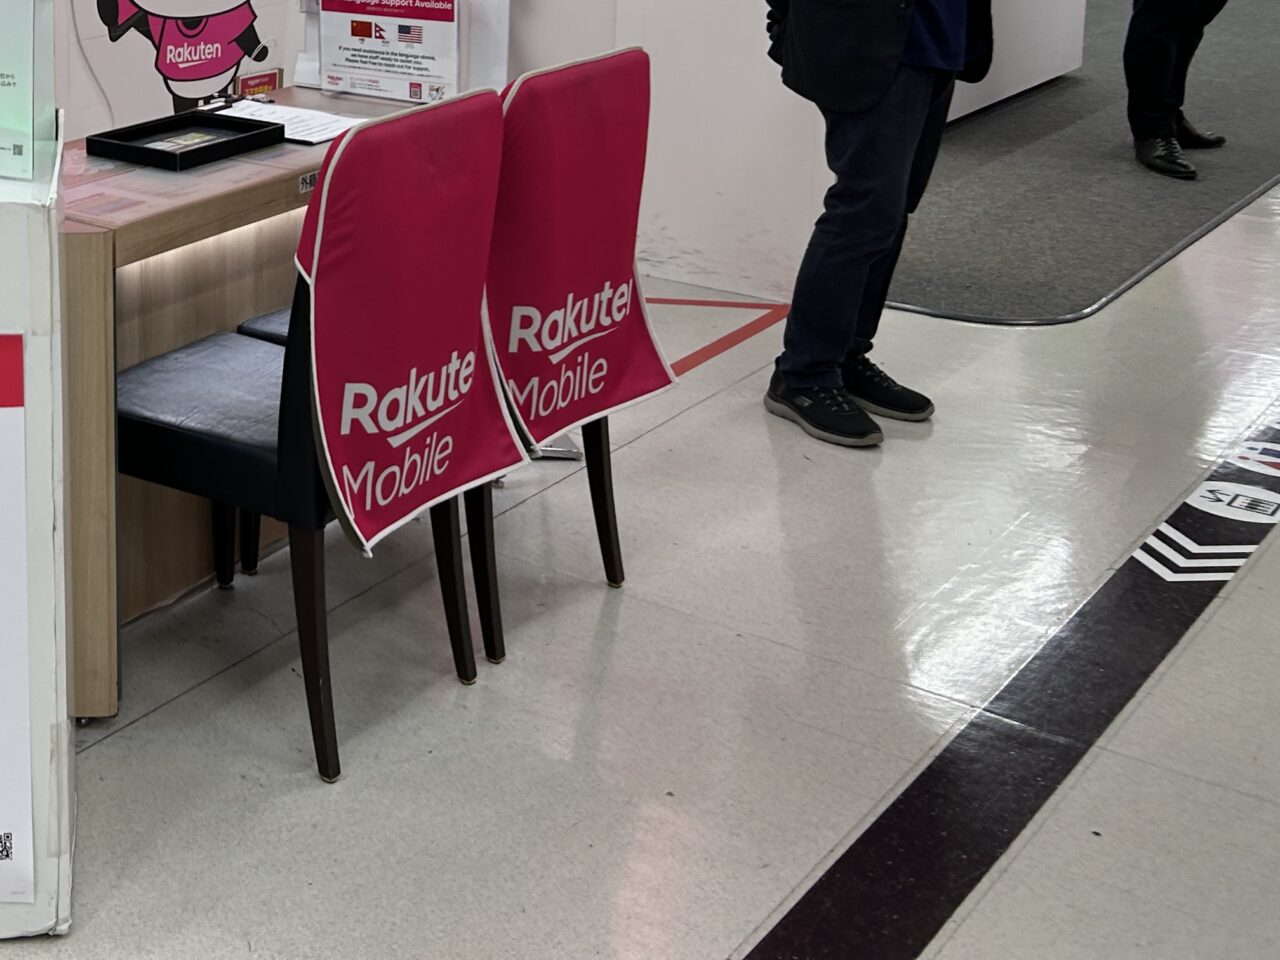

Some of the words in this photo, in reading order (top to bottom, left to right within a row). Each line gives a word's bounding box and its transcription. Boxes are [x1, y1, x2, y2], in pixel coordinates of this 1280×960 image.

[415, 0, 452, 10] Available
[166, 40, 221, 68] Rakuten
[508, 278, 633, 364] Rakute
[508, 352, 608, 422] Mobile
[342, 432, 453, 519] Mobile
